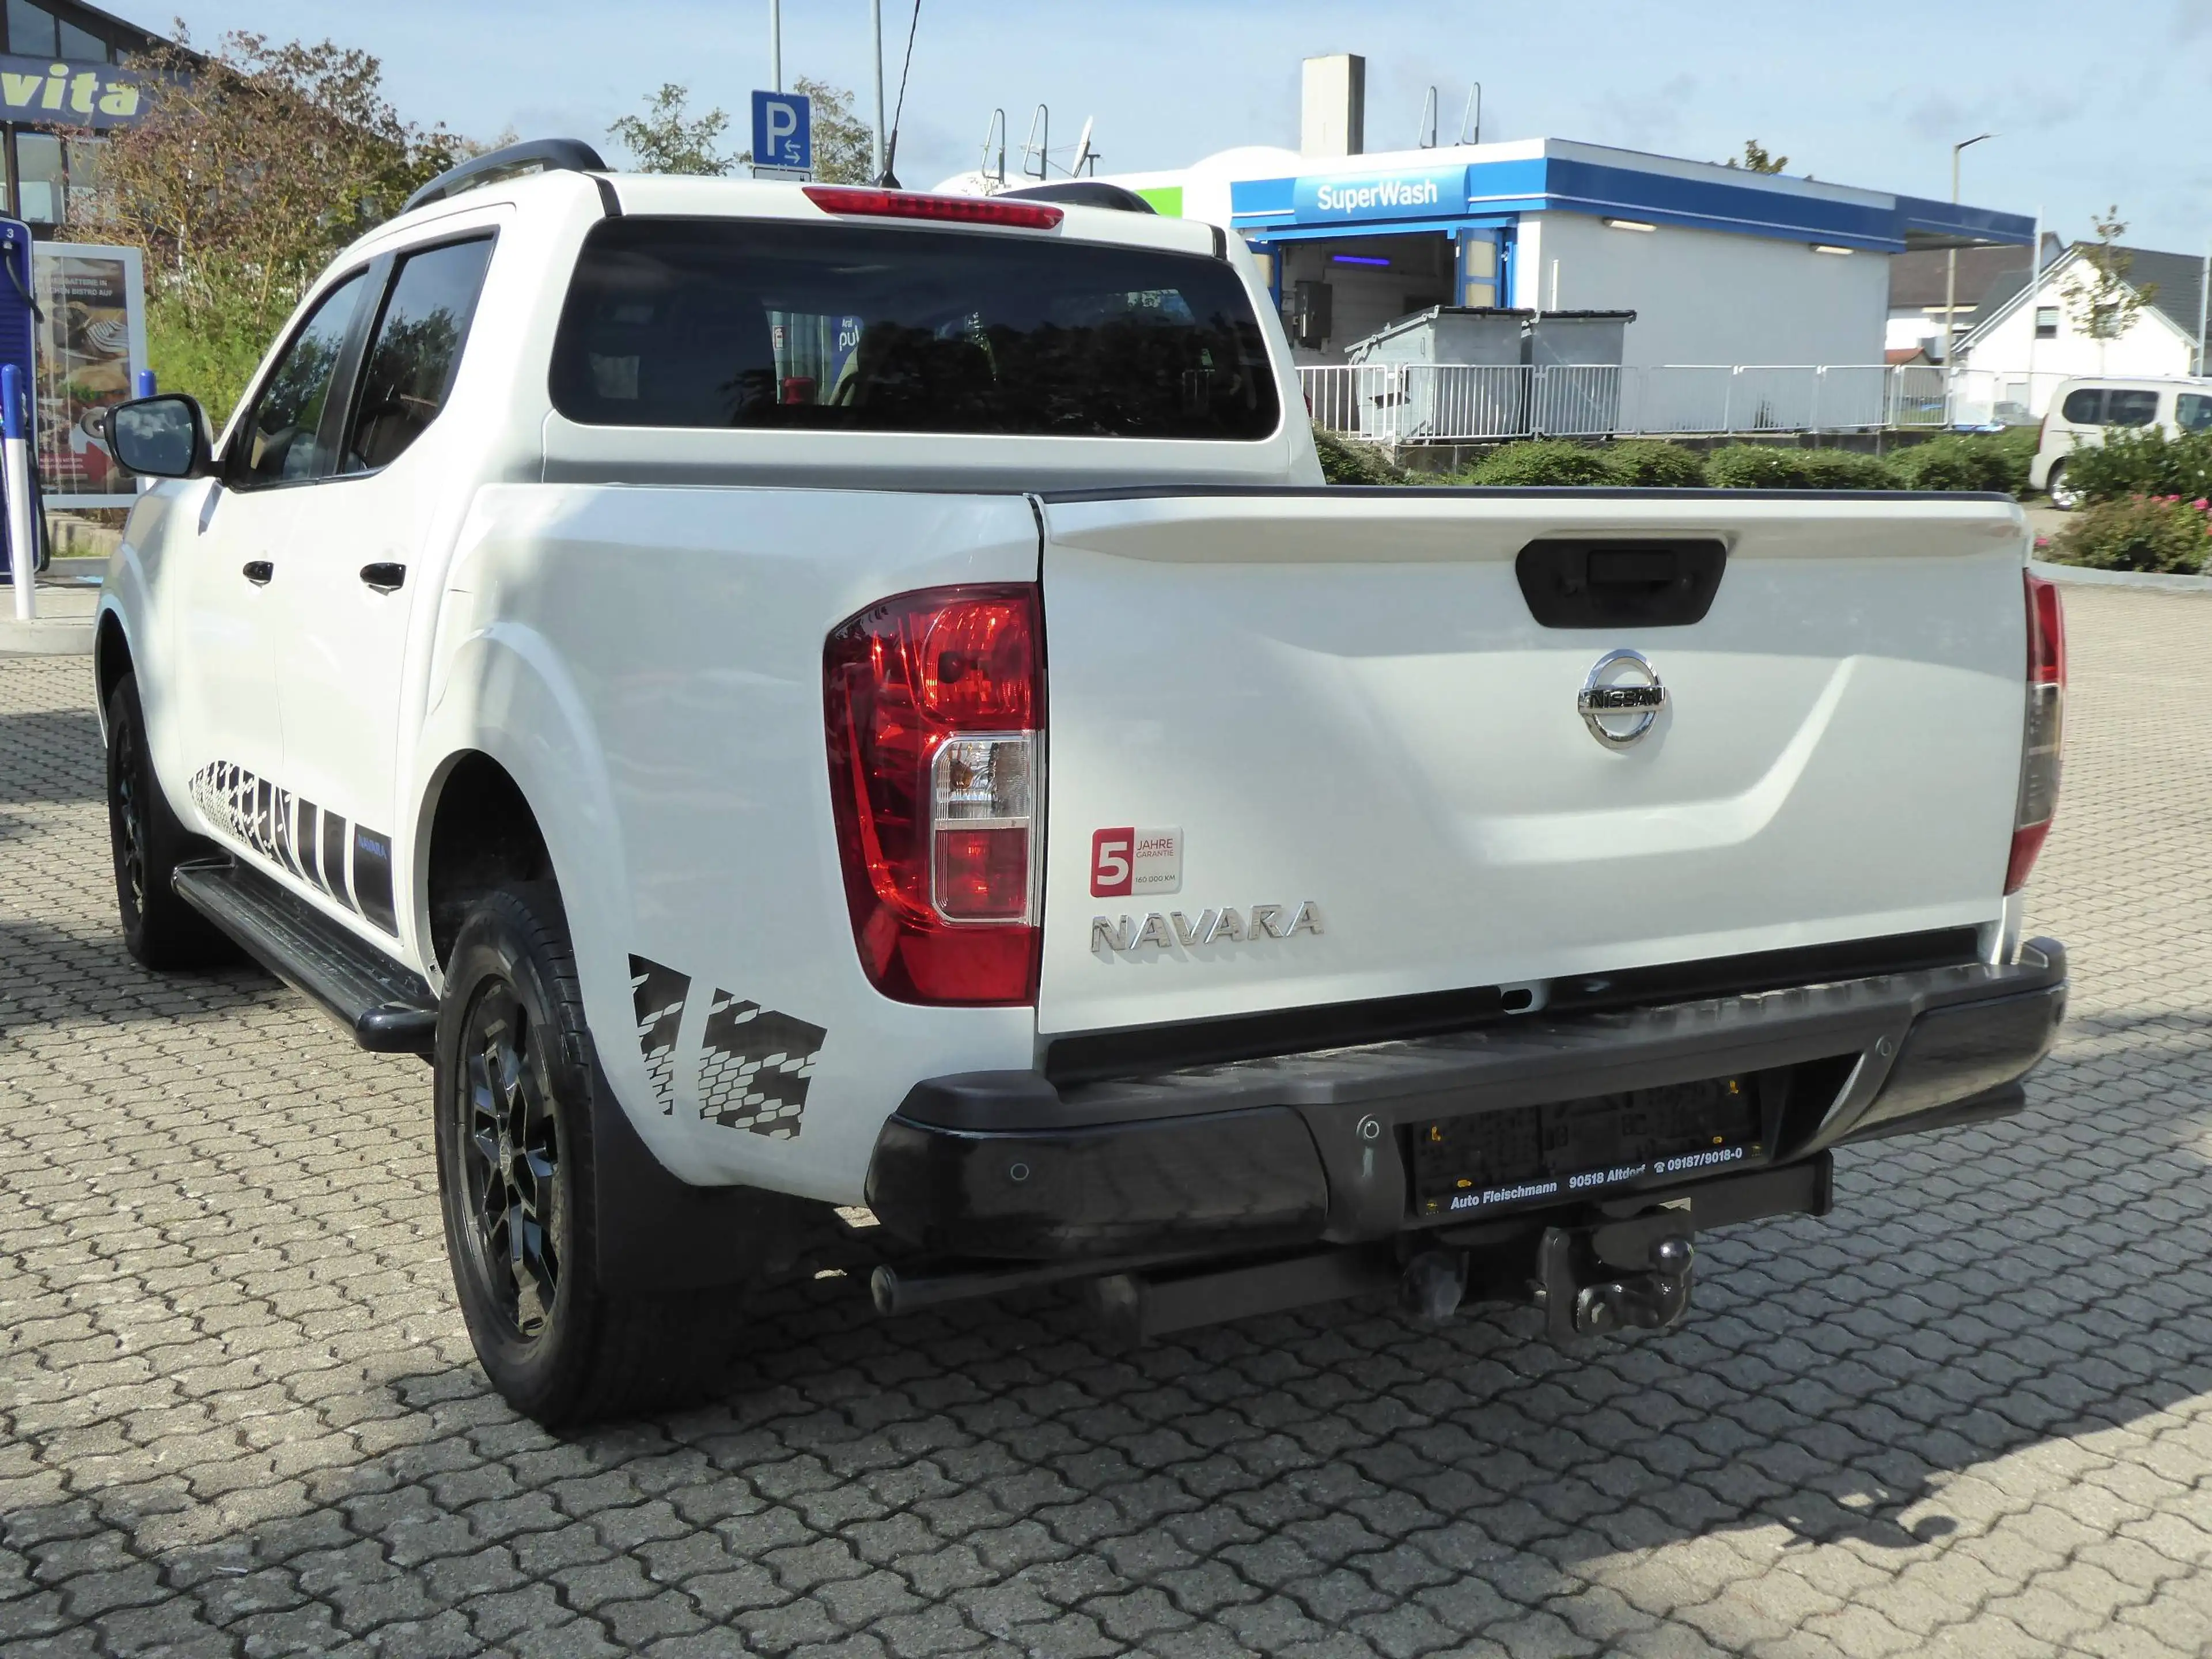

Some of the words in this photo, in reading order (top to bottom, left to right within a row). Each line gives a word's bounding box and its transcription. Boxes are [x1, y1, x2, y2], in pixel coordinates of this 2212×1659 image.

[1, 63, 140, 116] vita
[766, 101, 797, 156] P
[1317, 178, 1437, 214] SuperWash
[6, 228, 14, 238] 3
[842, 318, 853, 328] Aral
[1588, 687, 1658, 709] NISSAN
[1136, 849, 1174, 858] GARANTIE
[1137, 839, 1173, 850] JAHRE
[1097, 841, 1129, 886] 5
[1090, 900, 1325, 953] NAVARA
[1450, 1195, 1479, 1210] Auto
[1483, 1182, 1558, 1204] Fleischmann
[1569, 1172, 1604, 1188] 90518
[1667, 1147, 1743, 1171] 09187/9018-0
